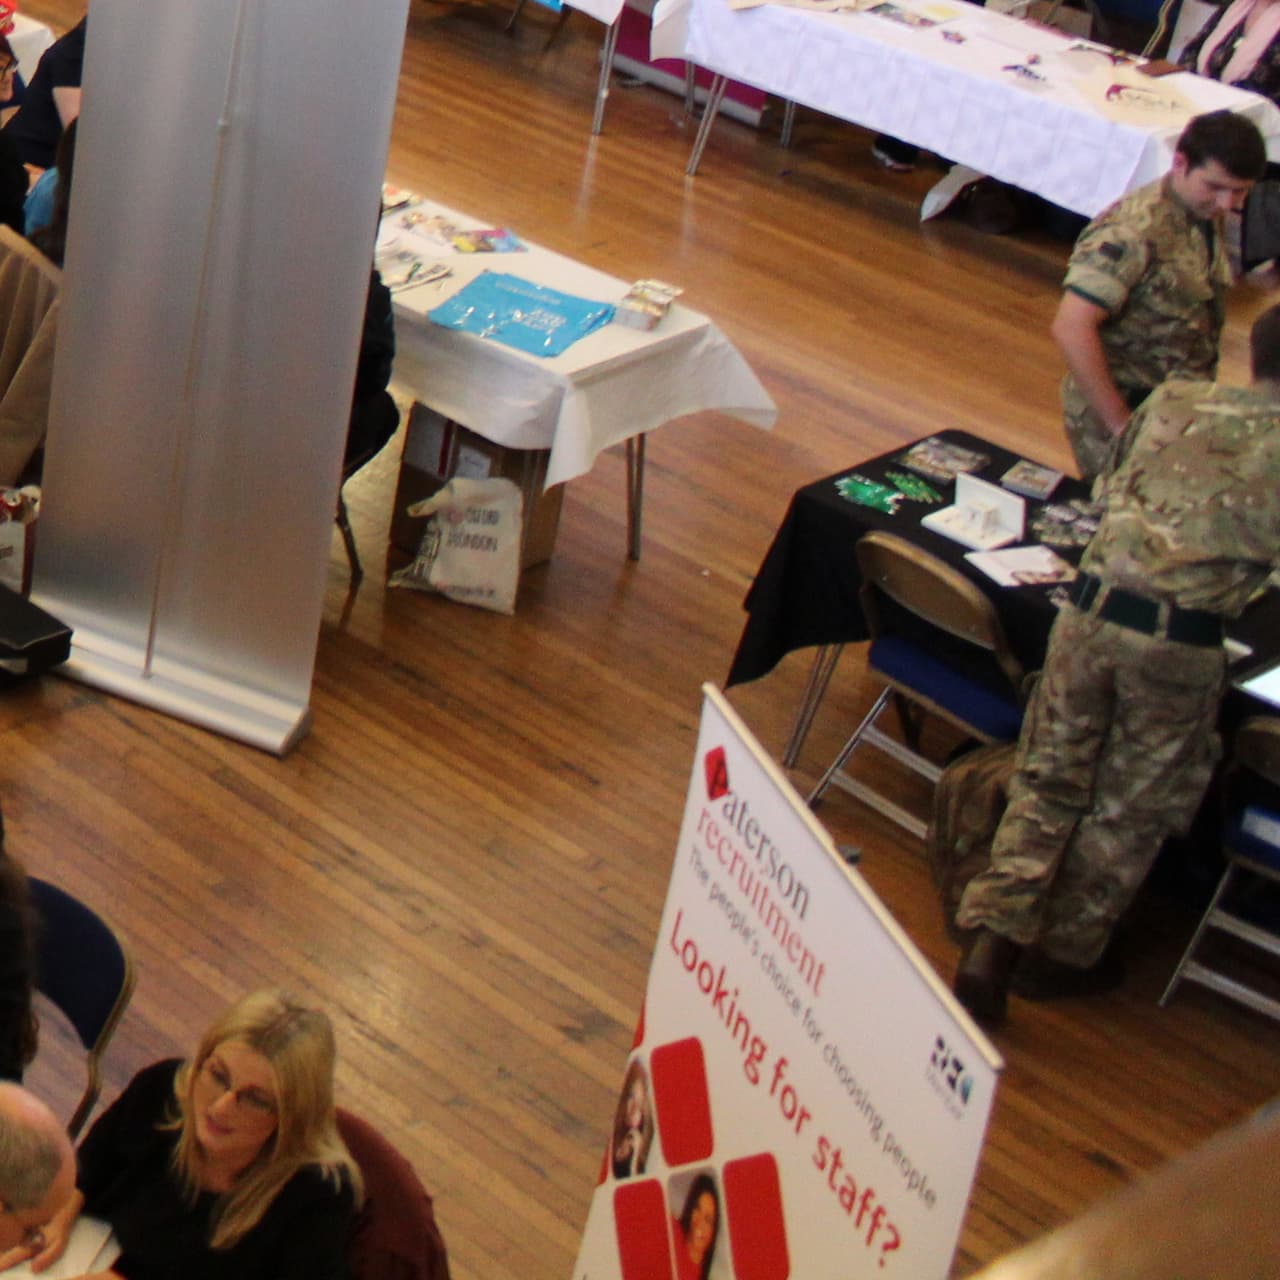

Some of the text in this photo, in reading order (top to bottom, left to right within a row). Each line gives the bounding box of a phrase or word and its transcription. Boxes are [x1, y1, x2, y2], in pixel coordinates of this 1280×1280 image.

[690, 842, 938, 1210] The people's choice for choosing people
[696, 806, 826, 998] recruitment
[669, 908, 902, 1269] Looking for staff?
